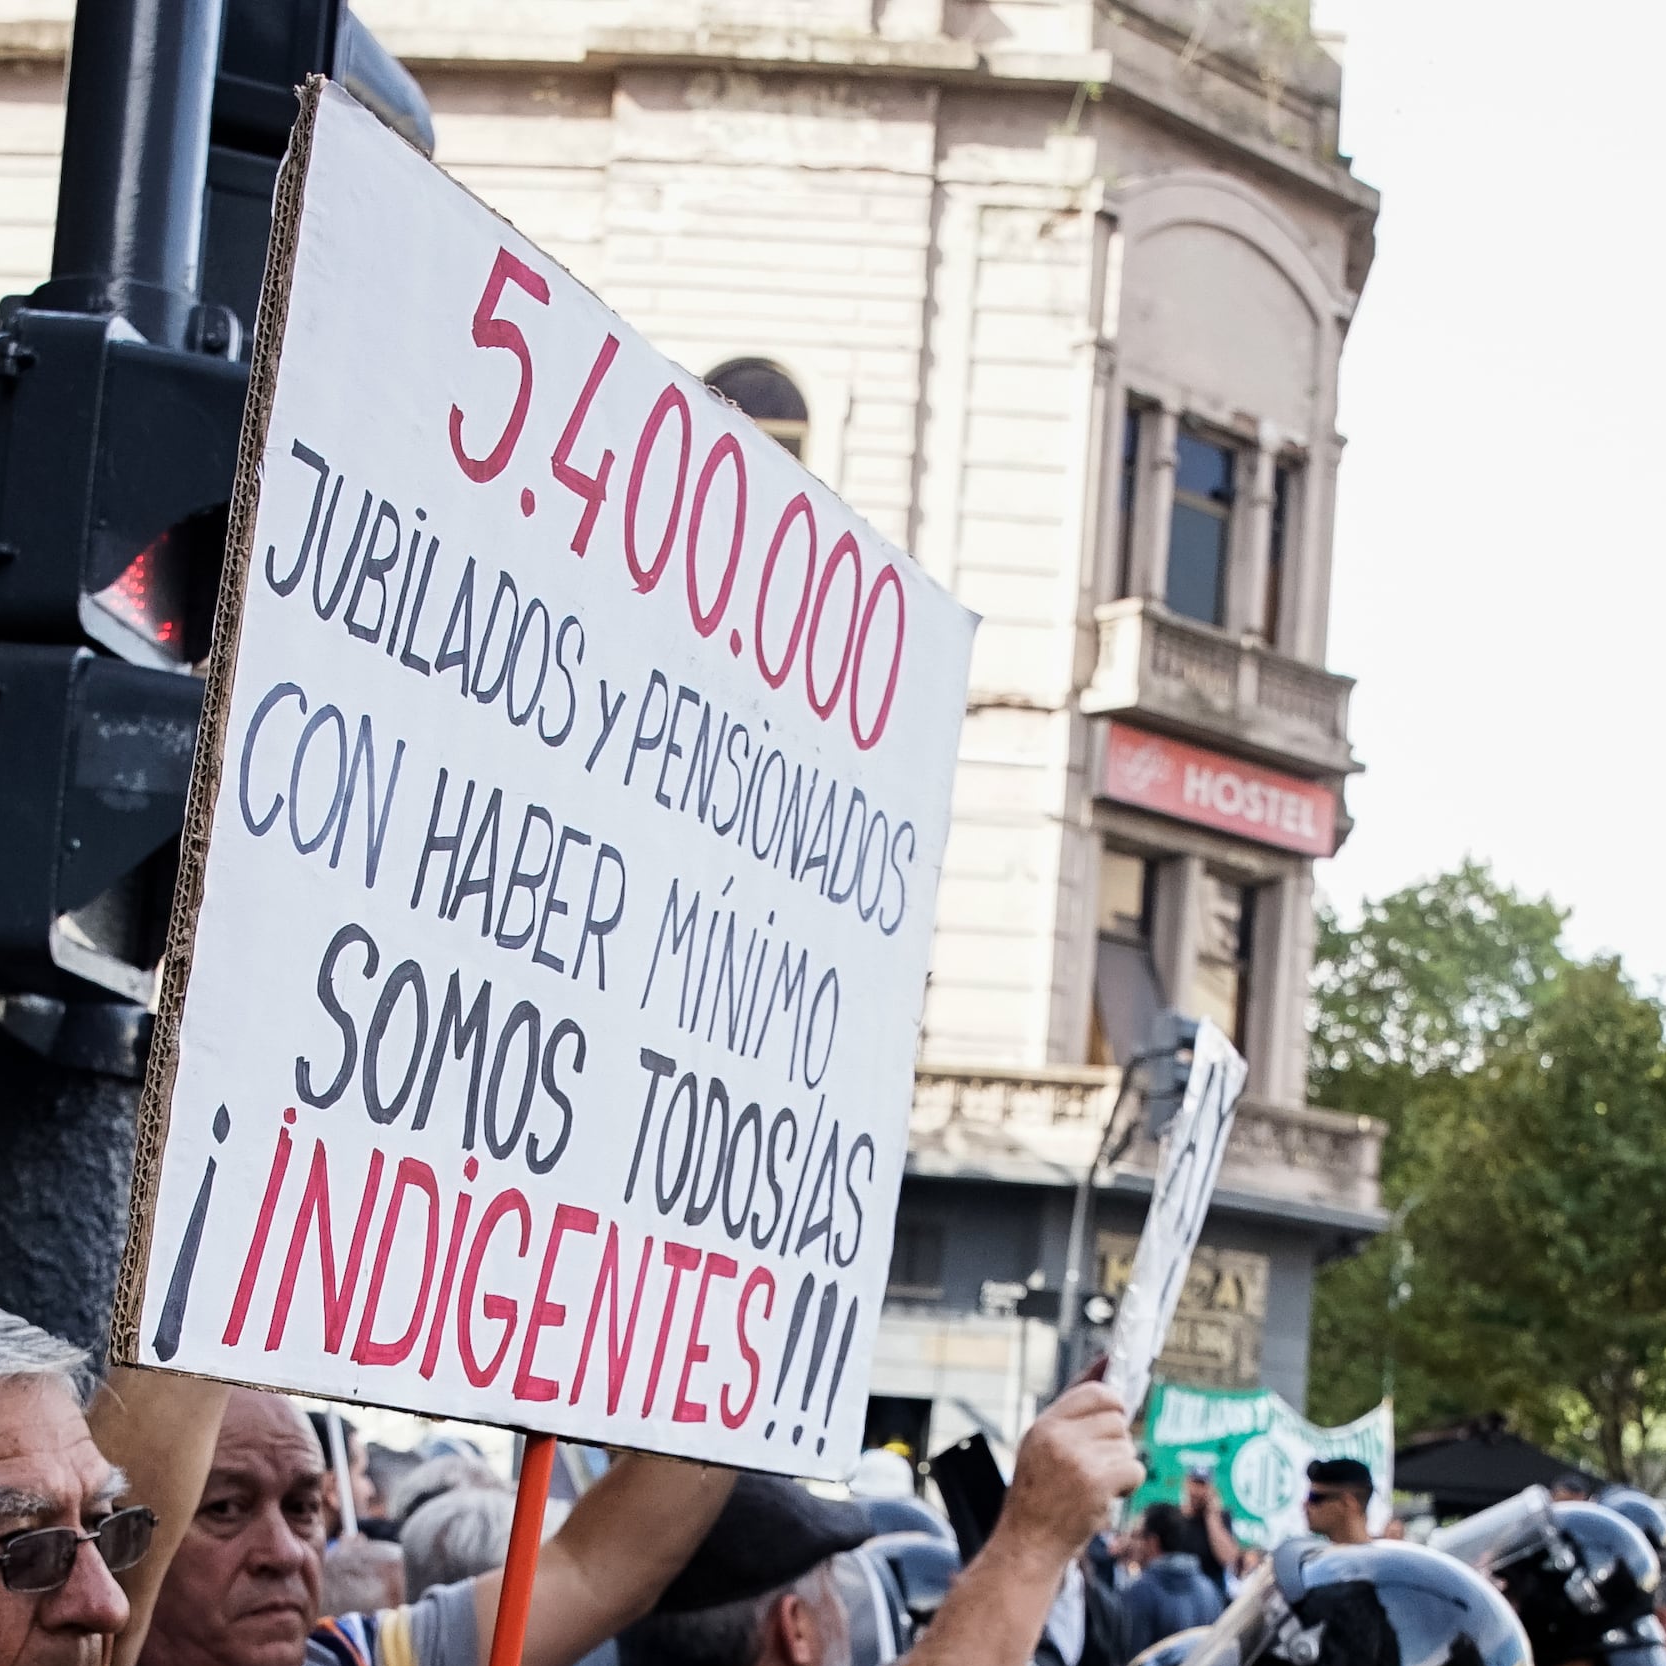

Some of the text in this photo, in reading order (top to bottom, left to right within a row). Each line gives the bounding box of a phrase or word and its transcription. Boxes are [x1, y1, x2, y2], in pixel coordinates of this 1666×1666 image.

[449, 247, 906, 751] 5.400.000
[240, 682, 404, 887] CON
[411, 767, 625, 990] HABER
[1185, 763, 1317, 838] HOSTEL
[295, 923, 585, 1175] SOMOS
[624, 1048, 875, 1269] TODOS/AS
